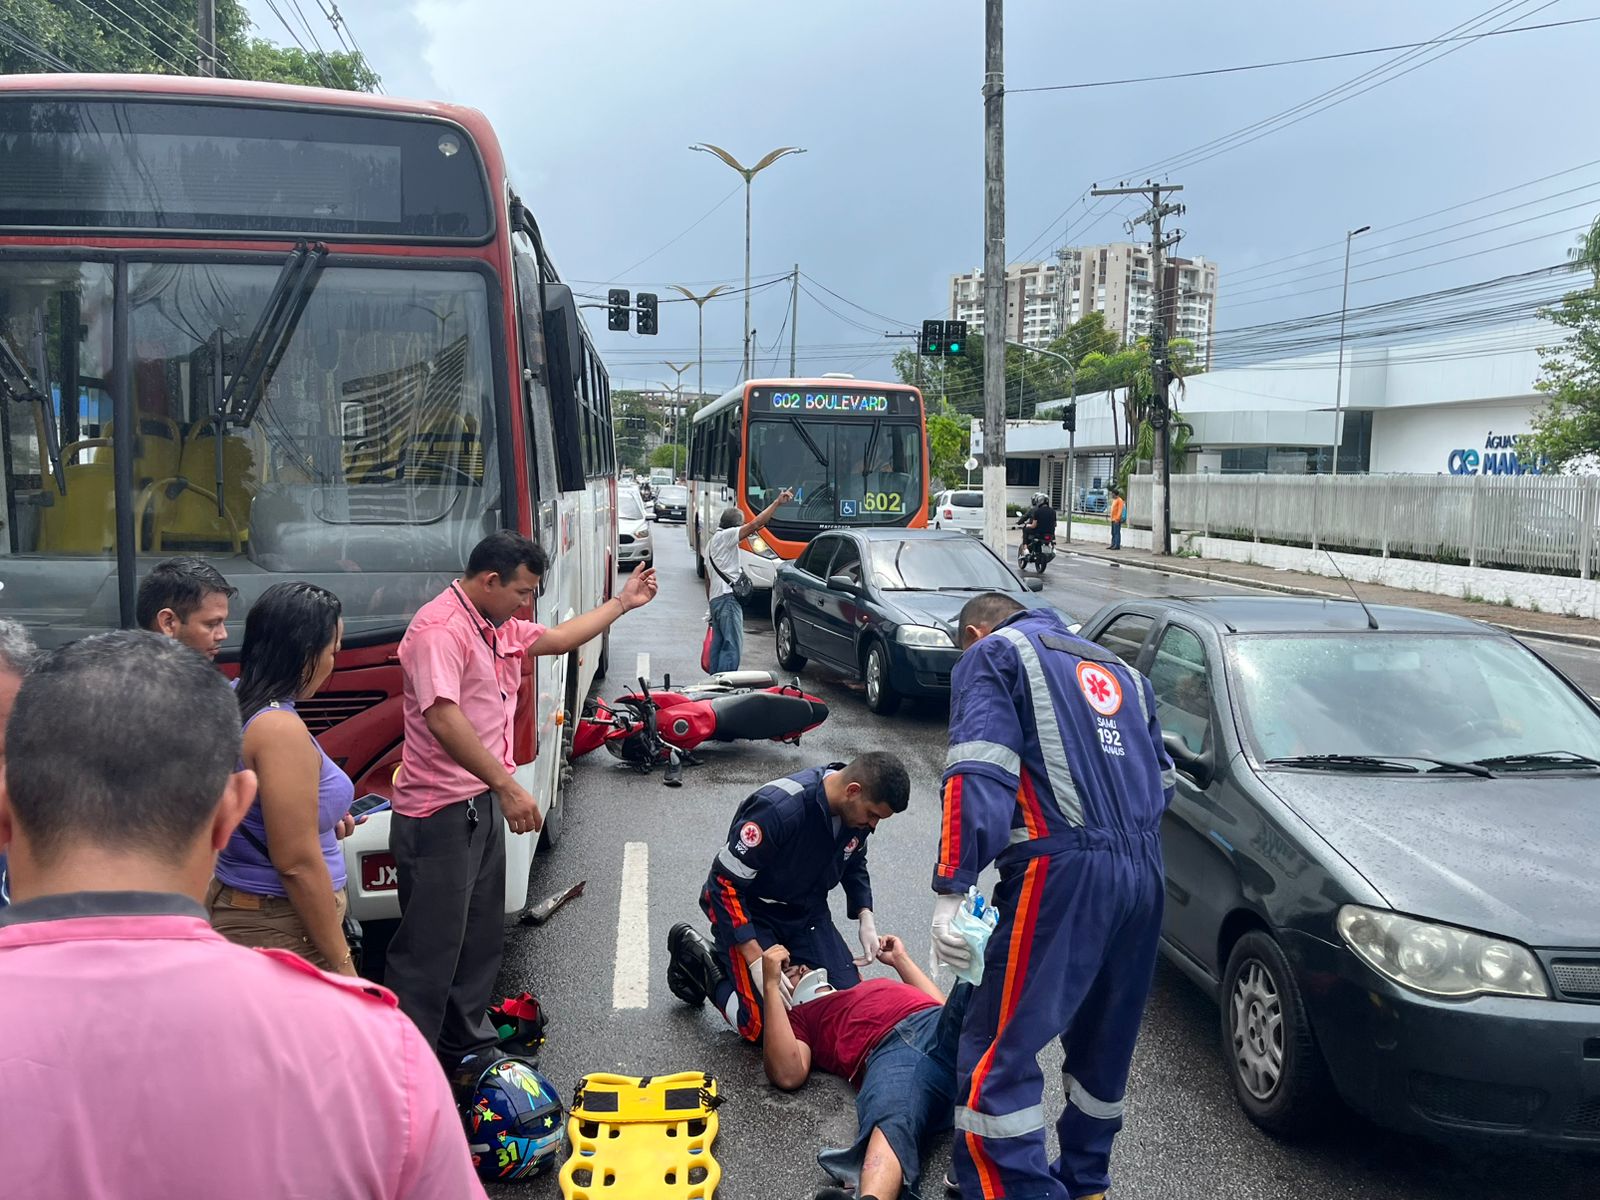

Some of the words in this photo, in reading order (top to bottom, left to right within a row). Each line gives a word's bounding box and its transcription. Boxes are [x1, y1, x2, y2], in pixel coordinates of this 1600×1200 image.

[773, 392, 800, 408] 602
[805, 393, 888, 411] BOULEVARD
[1485, 431, 1518, 449] ÁGUAS
[864, 492, 901, 511] 602
[1097, 716, 1116, 729] SAMU
[1097, 728, 1122, 746] 192
[371, 866, 398, 885] JX
[496, 1141, 518, 1167] 31
